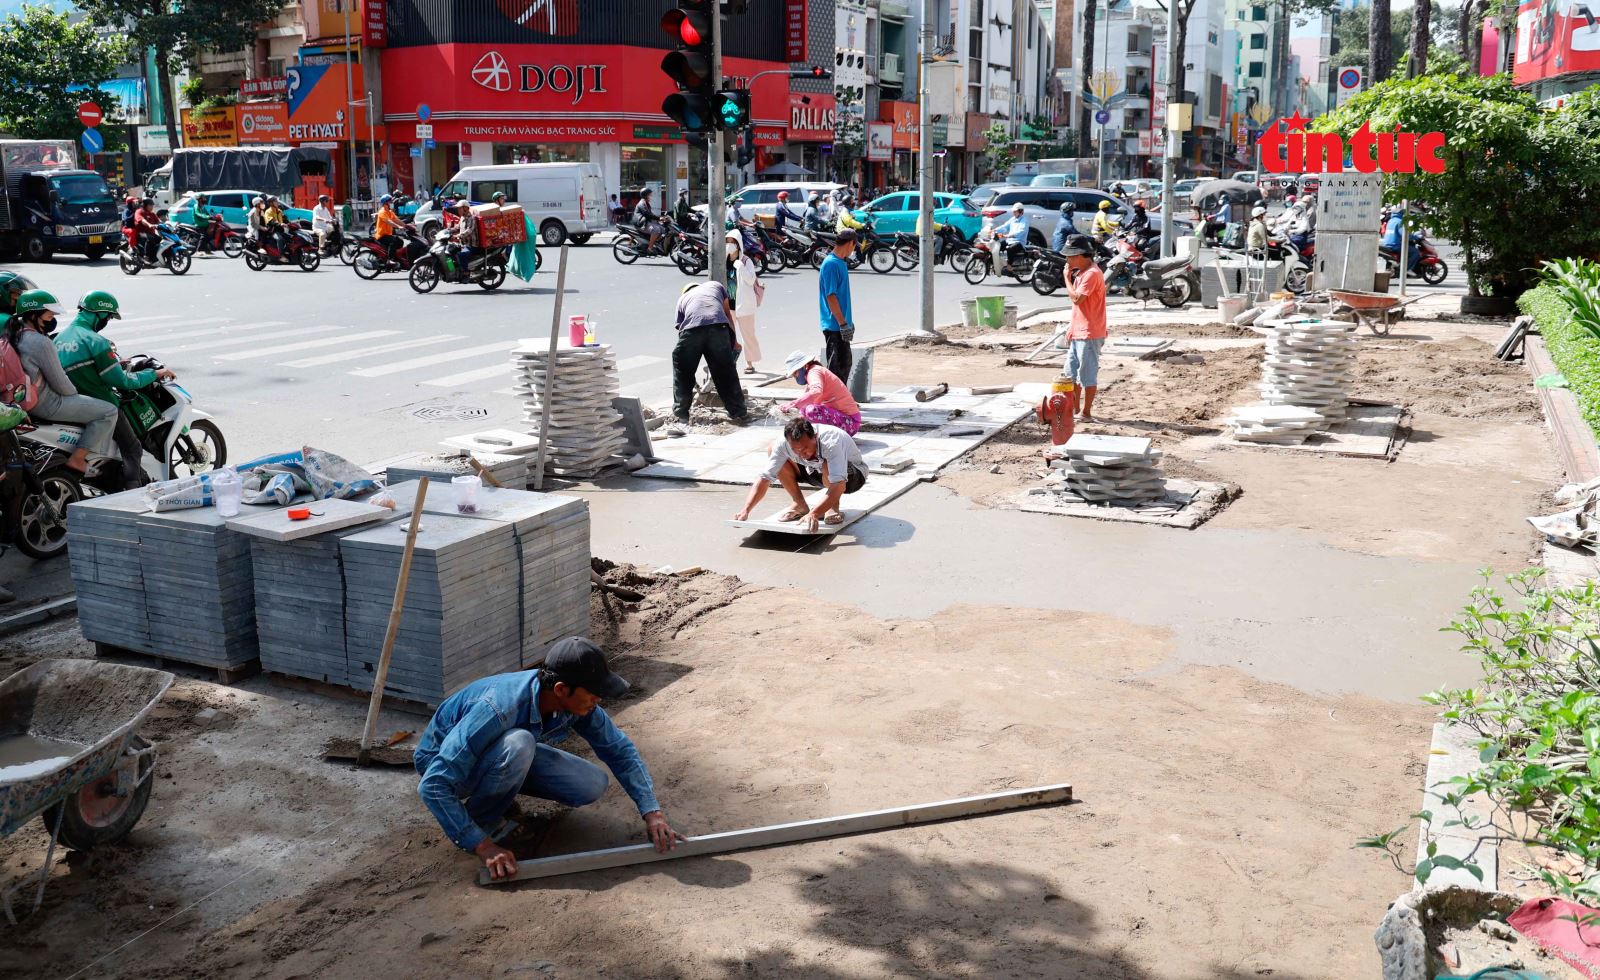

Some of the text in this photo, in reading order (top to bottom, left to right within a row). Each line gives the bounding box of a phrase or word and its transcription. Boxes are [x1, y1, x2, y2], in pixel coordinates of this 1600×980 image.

[518, 64, 607, 105] DOJI
[792, 107, 835, 131] DALLAS
[289, 123, 344, 139] PET HYATT
[464, 125, 616, 137] TRUNG TÂM VÀNG BẠC TRANG SỨC
[56, 341, 79, 352] Grab
